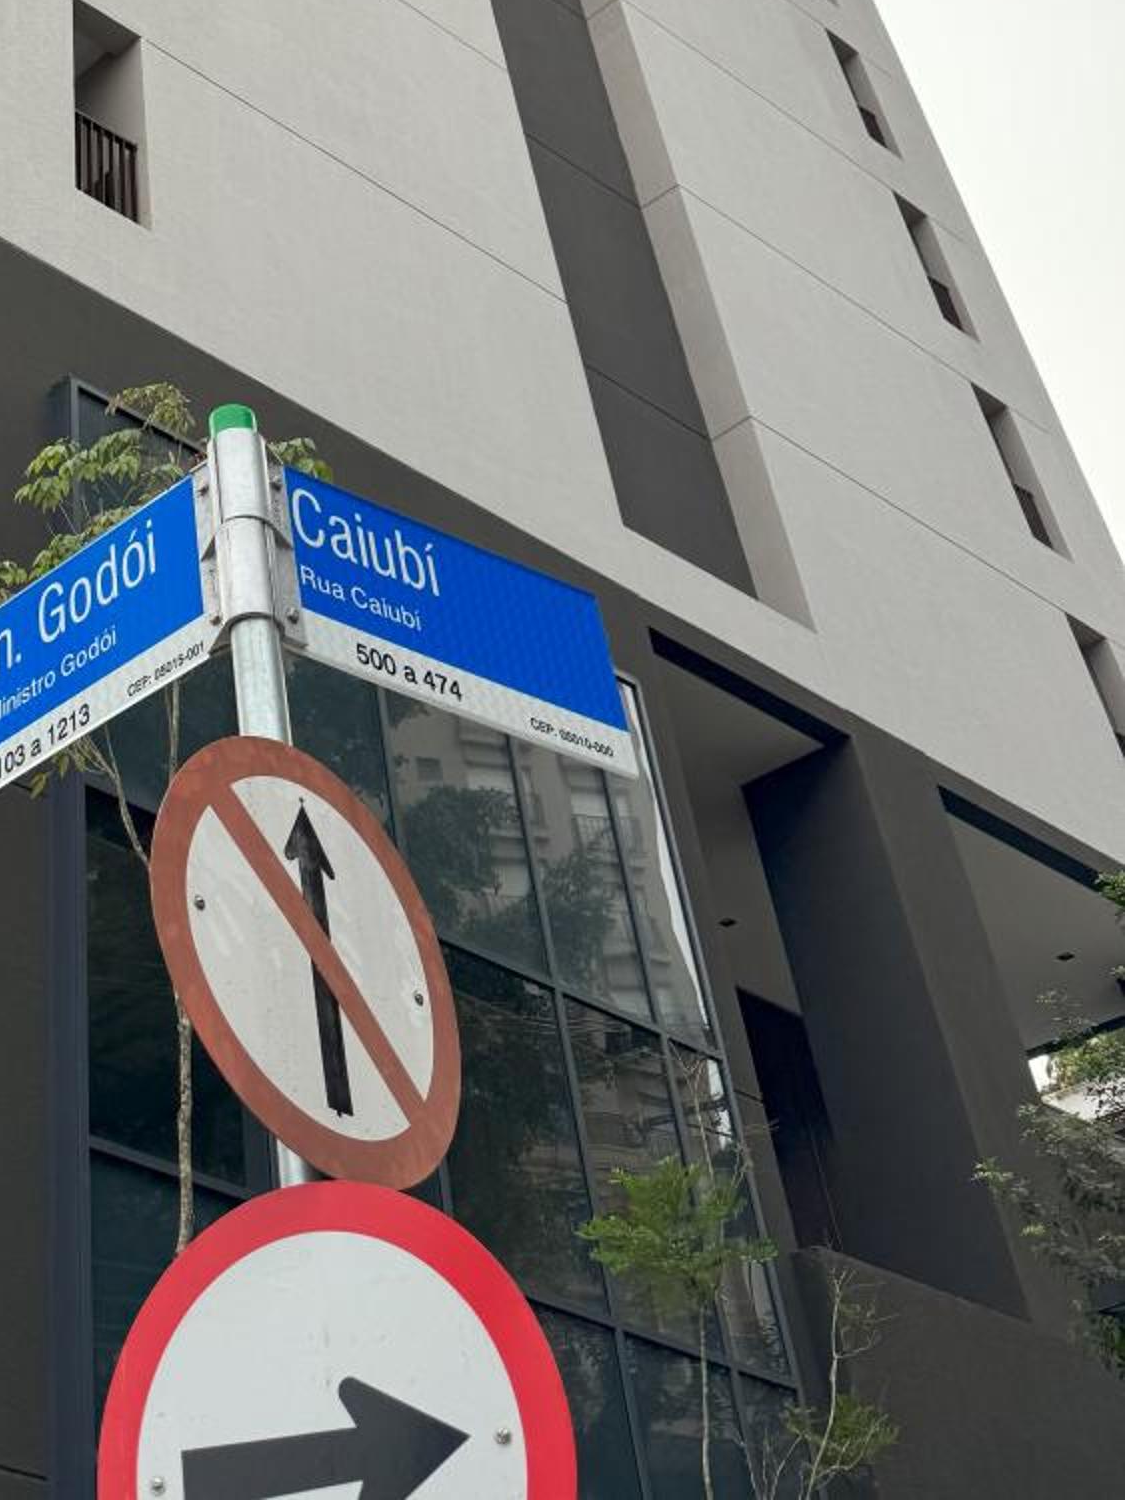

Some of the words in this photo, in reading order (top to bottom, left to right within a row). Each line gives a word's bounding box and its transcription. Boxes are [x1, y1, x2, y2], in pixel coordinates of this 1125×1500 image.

[291, 487, 441, 597] Caiubí
[37, 518, 157, 644] Godói
[300, 563, 346, 602] Rua
[60, 624, 117, 677] Godói
[356, 642, 397, 676] 500
[404, 664, 418, 685] a
[423, 670, 463, 703] 474
[127, 675, 152, 697] CEP:
[30, 738, 42, 757] a
[47, 702, 91, 746] 1213
